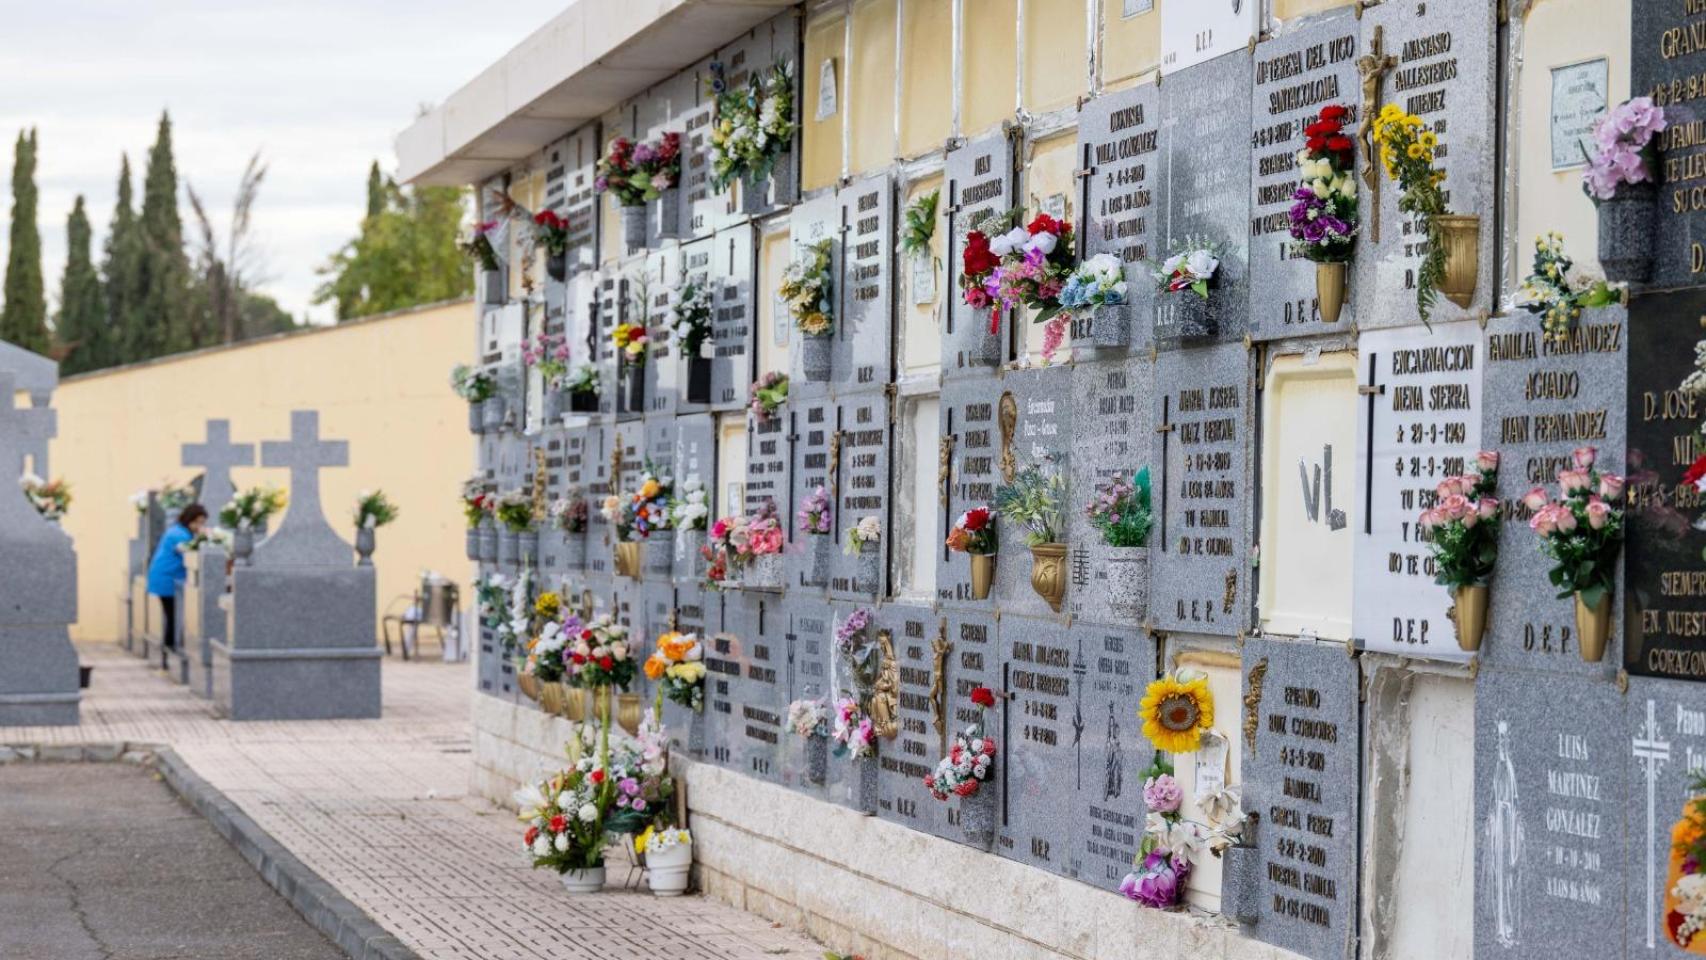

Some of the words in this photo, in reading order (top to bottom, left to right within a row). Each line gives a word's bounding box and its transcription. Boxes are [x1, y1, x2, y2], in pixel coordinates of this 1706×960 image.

[1329, 35, 1355, 64] VICO
[1392, 344, 1475, 376] ENCARNACION
[1392, 386, 1424, 412] MENA
[1429, 383, 1471, 411] SIERRA
[1525, 370, 1580, 401] AGUADO
[1501, 415, 1530, 445] JUAN
[1534, 409, 1608, 443] FERNANDEZ
[1400, 489, 1414, 510] TU
[1402, 521, 1409, 543] Y
[1389, 552, 1402, 573] NO
[1406, 554, 1418, 576] TE
[1558, 733, 1589, 761] LUISA
[1548, 769, 1601, 801] MARTINEZ
[1546, 807, 1601, 840] GONZALEZ
